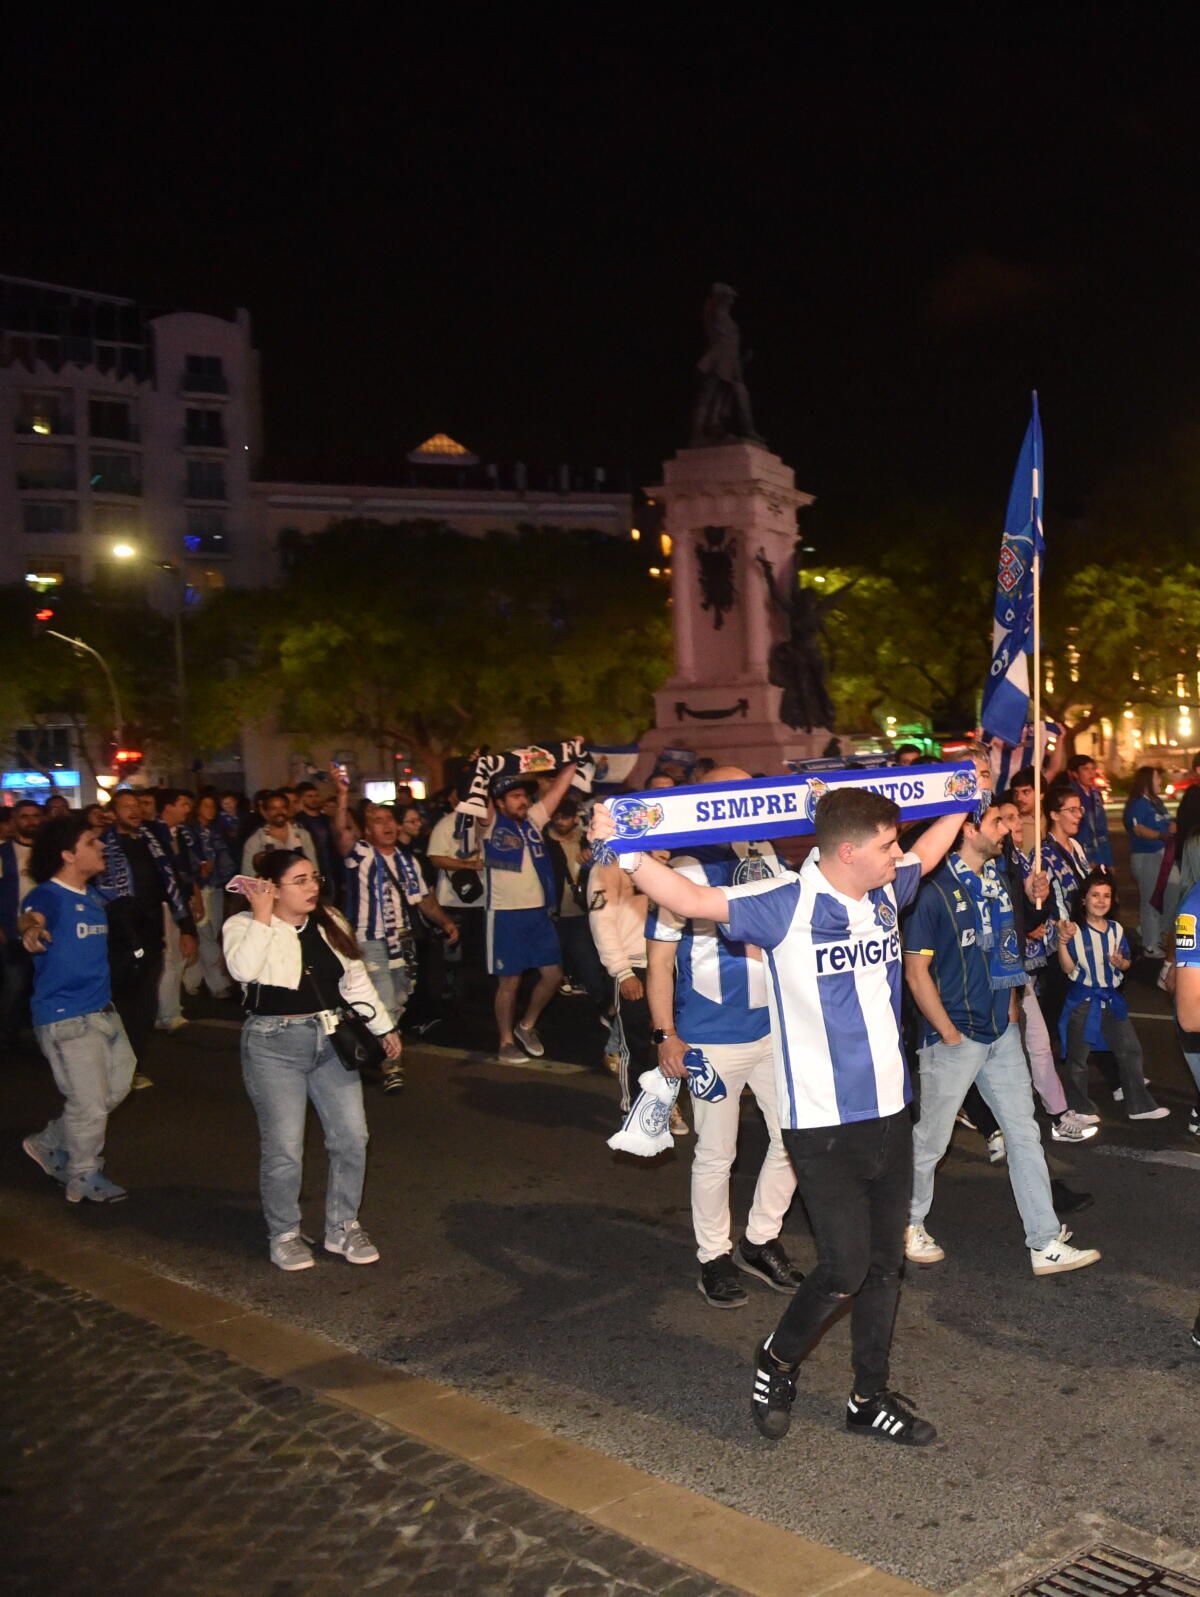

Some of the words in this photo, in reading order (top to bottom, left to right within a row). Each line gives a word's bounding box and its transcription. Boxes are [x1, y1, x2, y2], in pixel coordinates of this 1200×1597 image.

[696, 792, 798, 823] SEMPRE
[869, 781, 925, 802] NTOS
[1167, 935, 1194, 948] win
